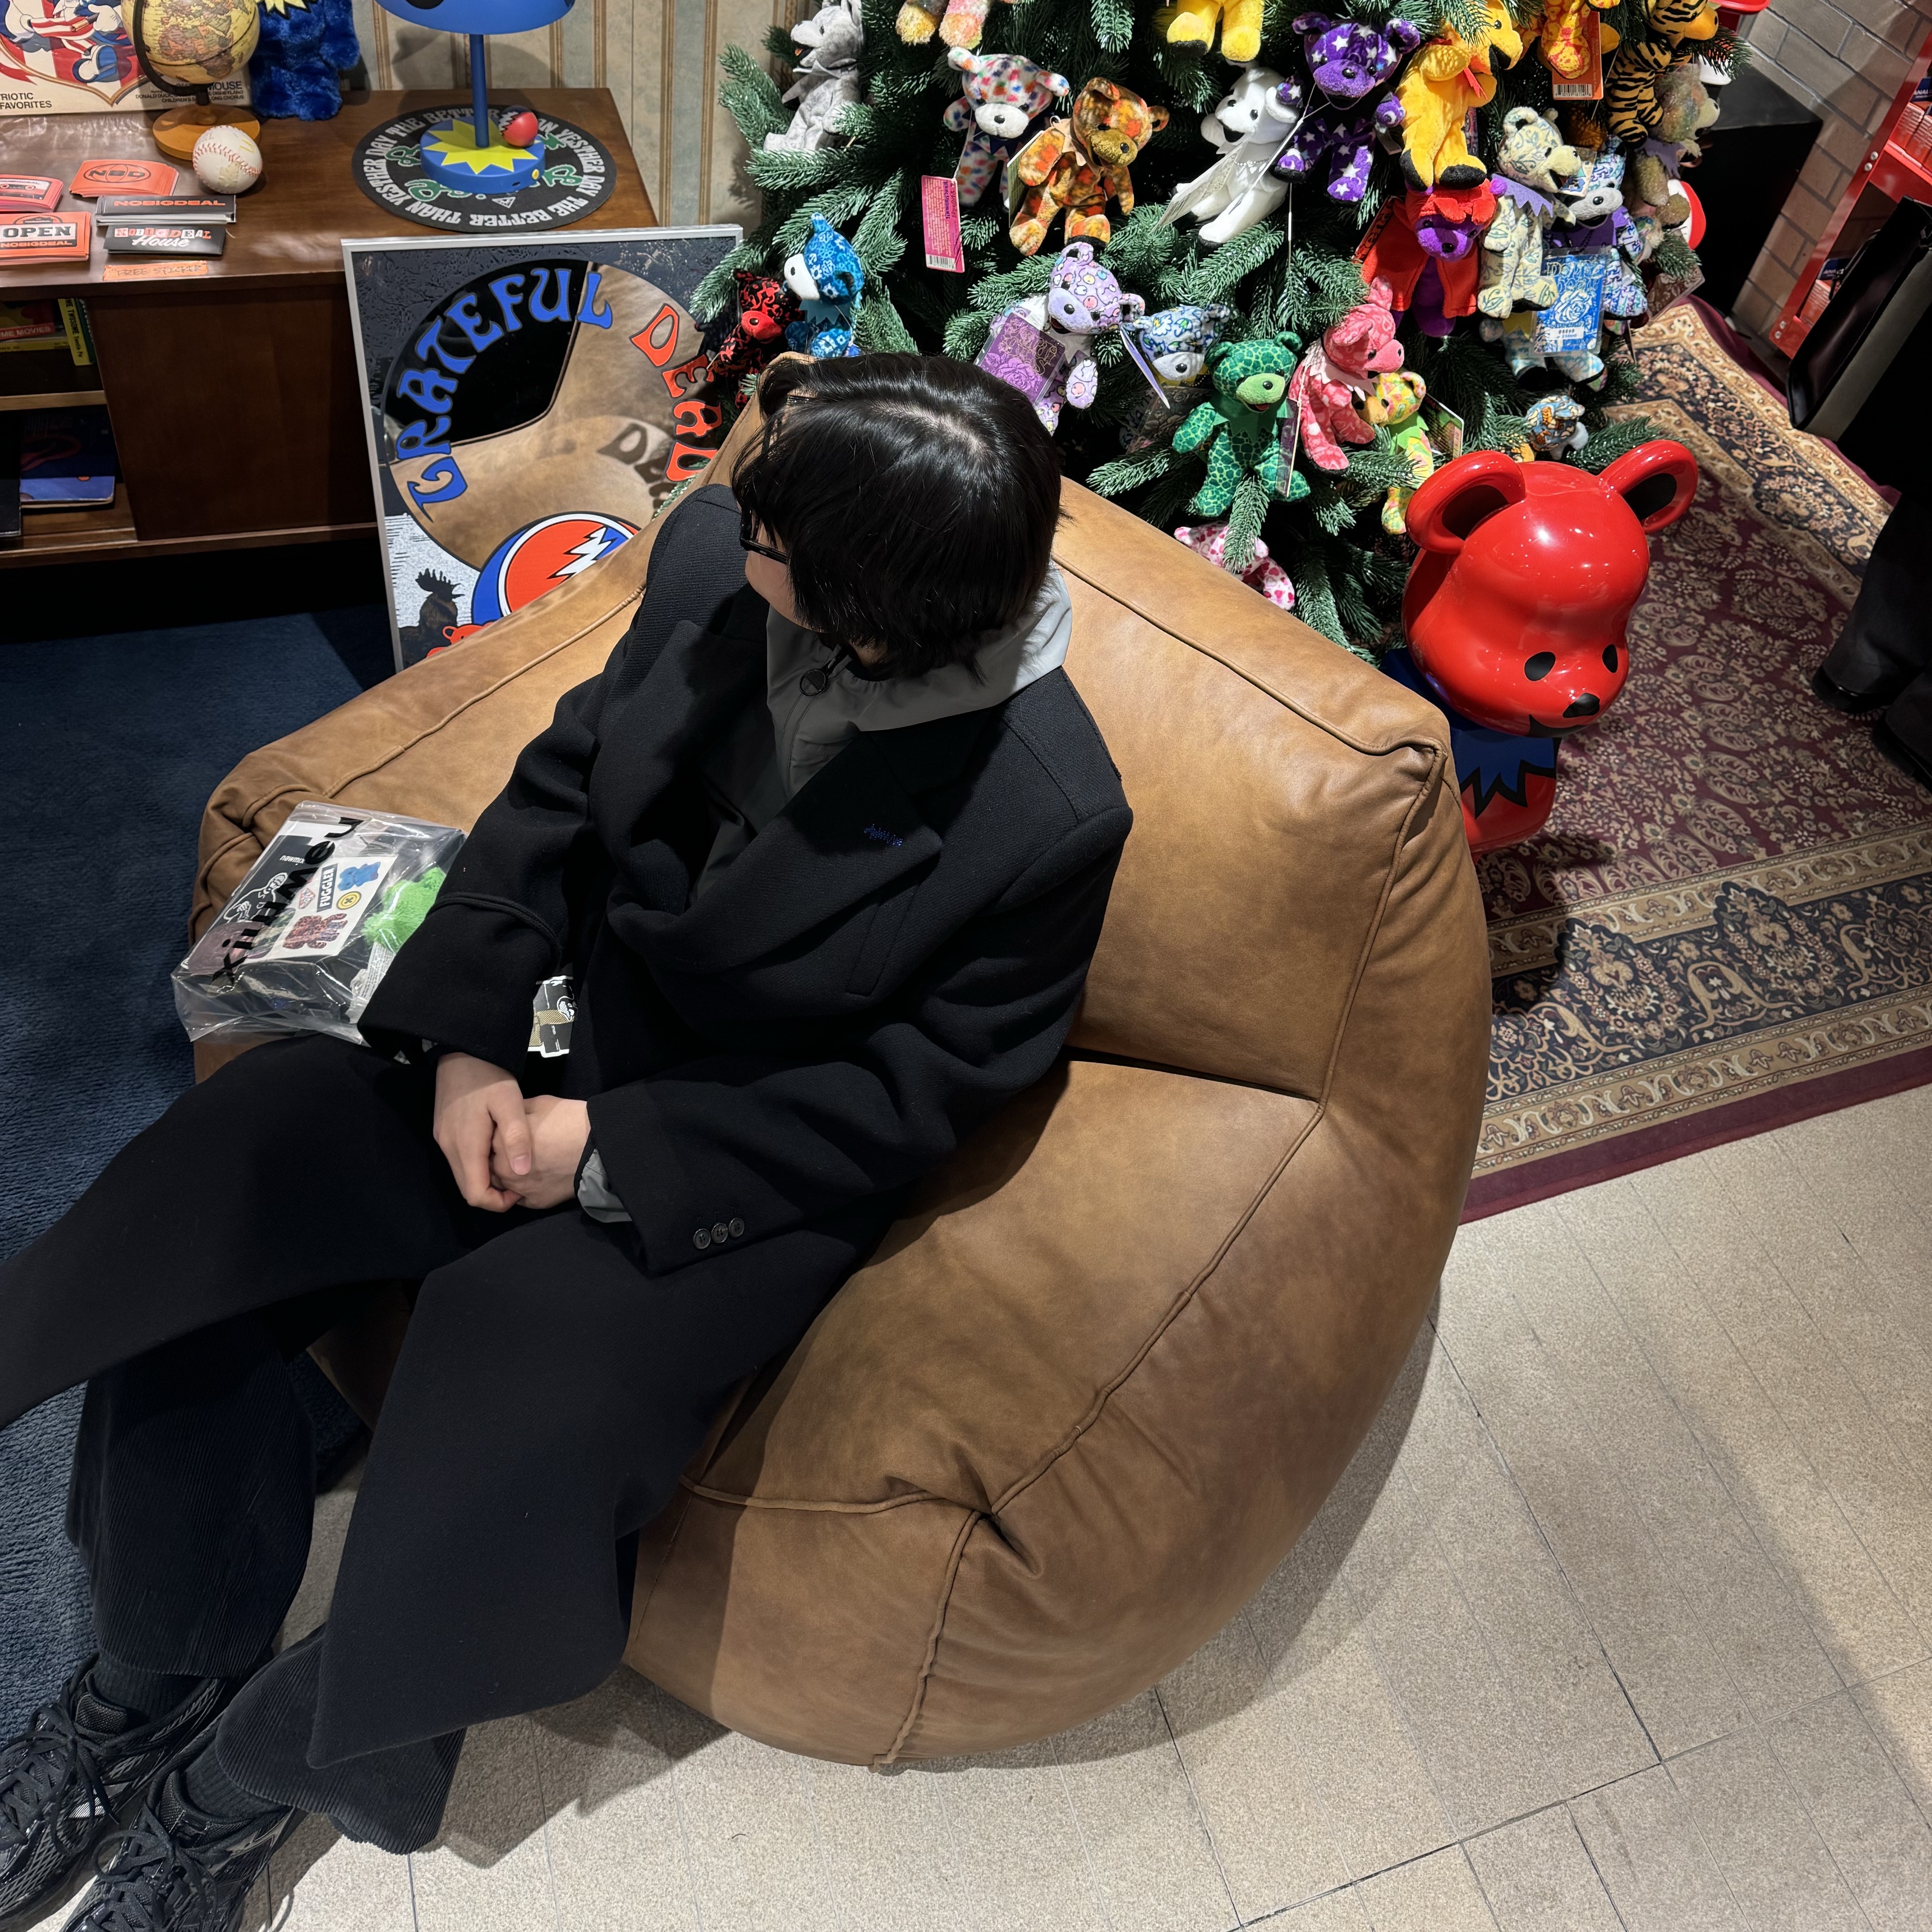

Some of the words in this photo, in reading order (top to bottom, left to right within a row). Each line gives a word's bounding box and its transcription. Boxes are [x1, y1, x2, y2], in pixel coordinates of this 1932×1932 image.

[208, 81, 242, 90] MOUSE
[0, 101, 52, 109] FAVORITES
[423, 108, 500, 124] BETTR
[385, 118, 426, 137] THE
[365, 135, 397, 156] DAY
[576, 175, 605, 197] DAY
[405, 201, 462, 224] THAN
[547, 196, 589, 216] THE
[469, 209, 553, 226] BETTER
[3, 226, 71, 238] OPEN
[115, 227, 211, 239] NOBIGDEAL
[132, 234, 189, 247] House
[17, 326, 51, 336] MOVIES
[396, 268, 613, 523] GRATEFUL
[632, 303, 722, 482] DEAD
[319, 867, 335, 908] FUGGLER
